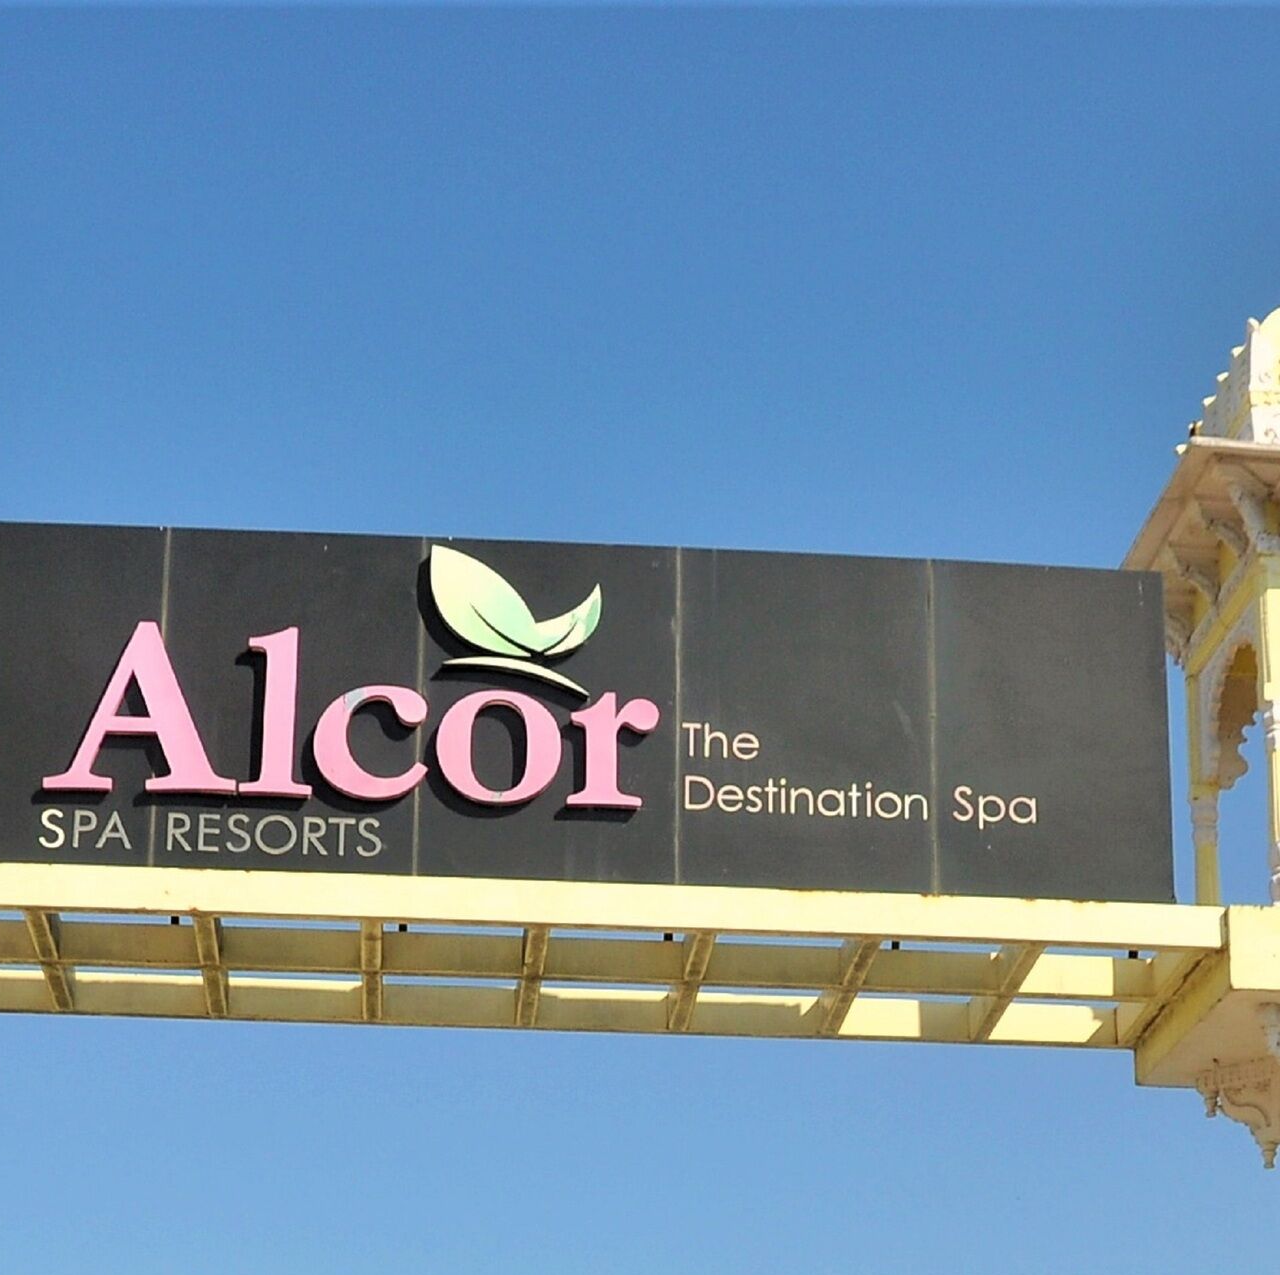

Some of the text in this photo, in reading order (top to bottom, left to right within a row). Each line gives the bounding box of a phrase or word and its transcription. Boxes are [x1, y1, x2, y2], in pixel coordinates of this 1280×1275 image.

[42, 620, 660, 810] Alcor
[681, 722, 760, 760] The
[683, 774, 1038, 829] Destination Spa
[38, 807, 383, 858] SPA RESORTS
